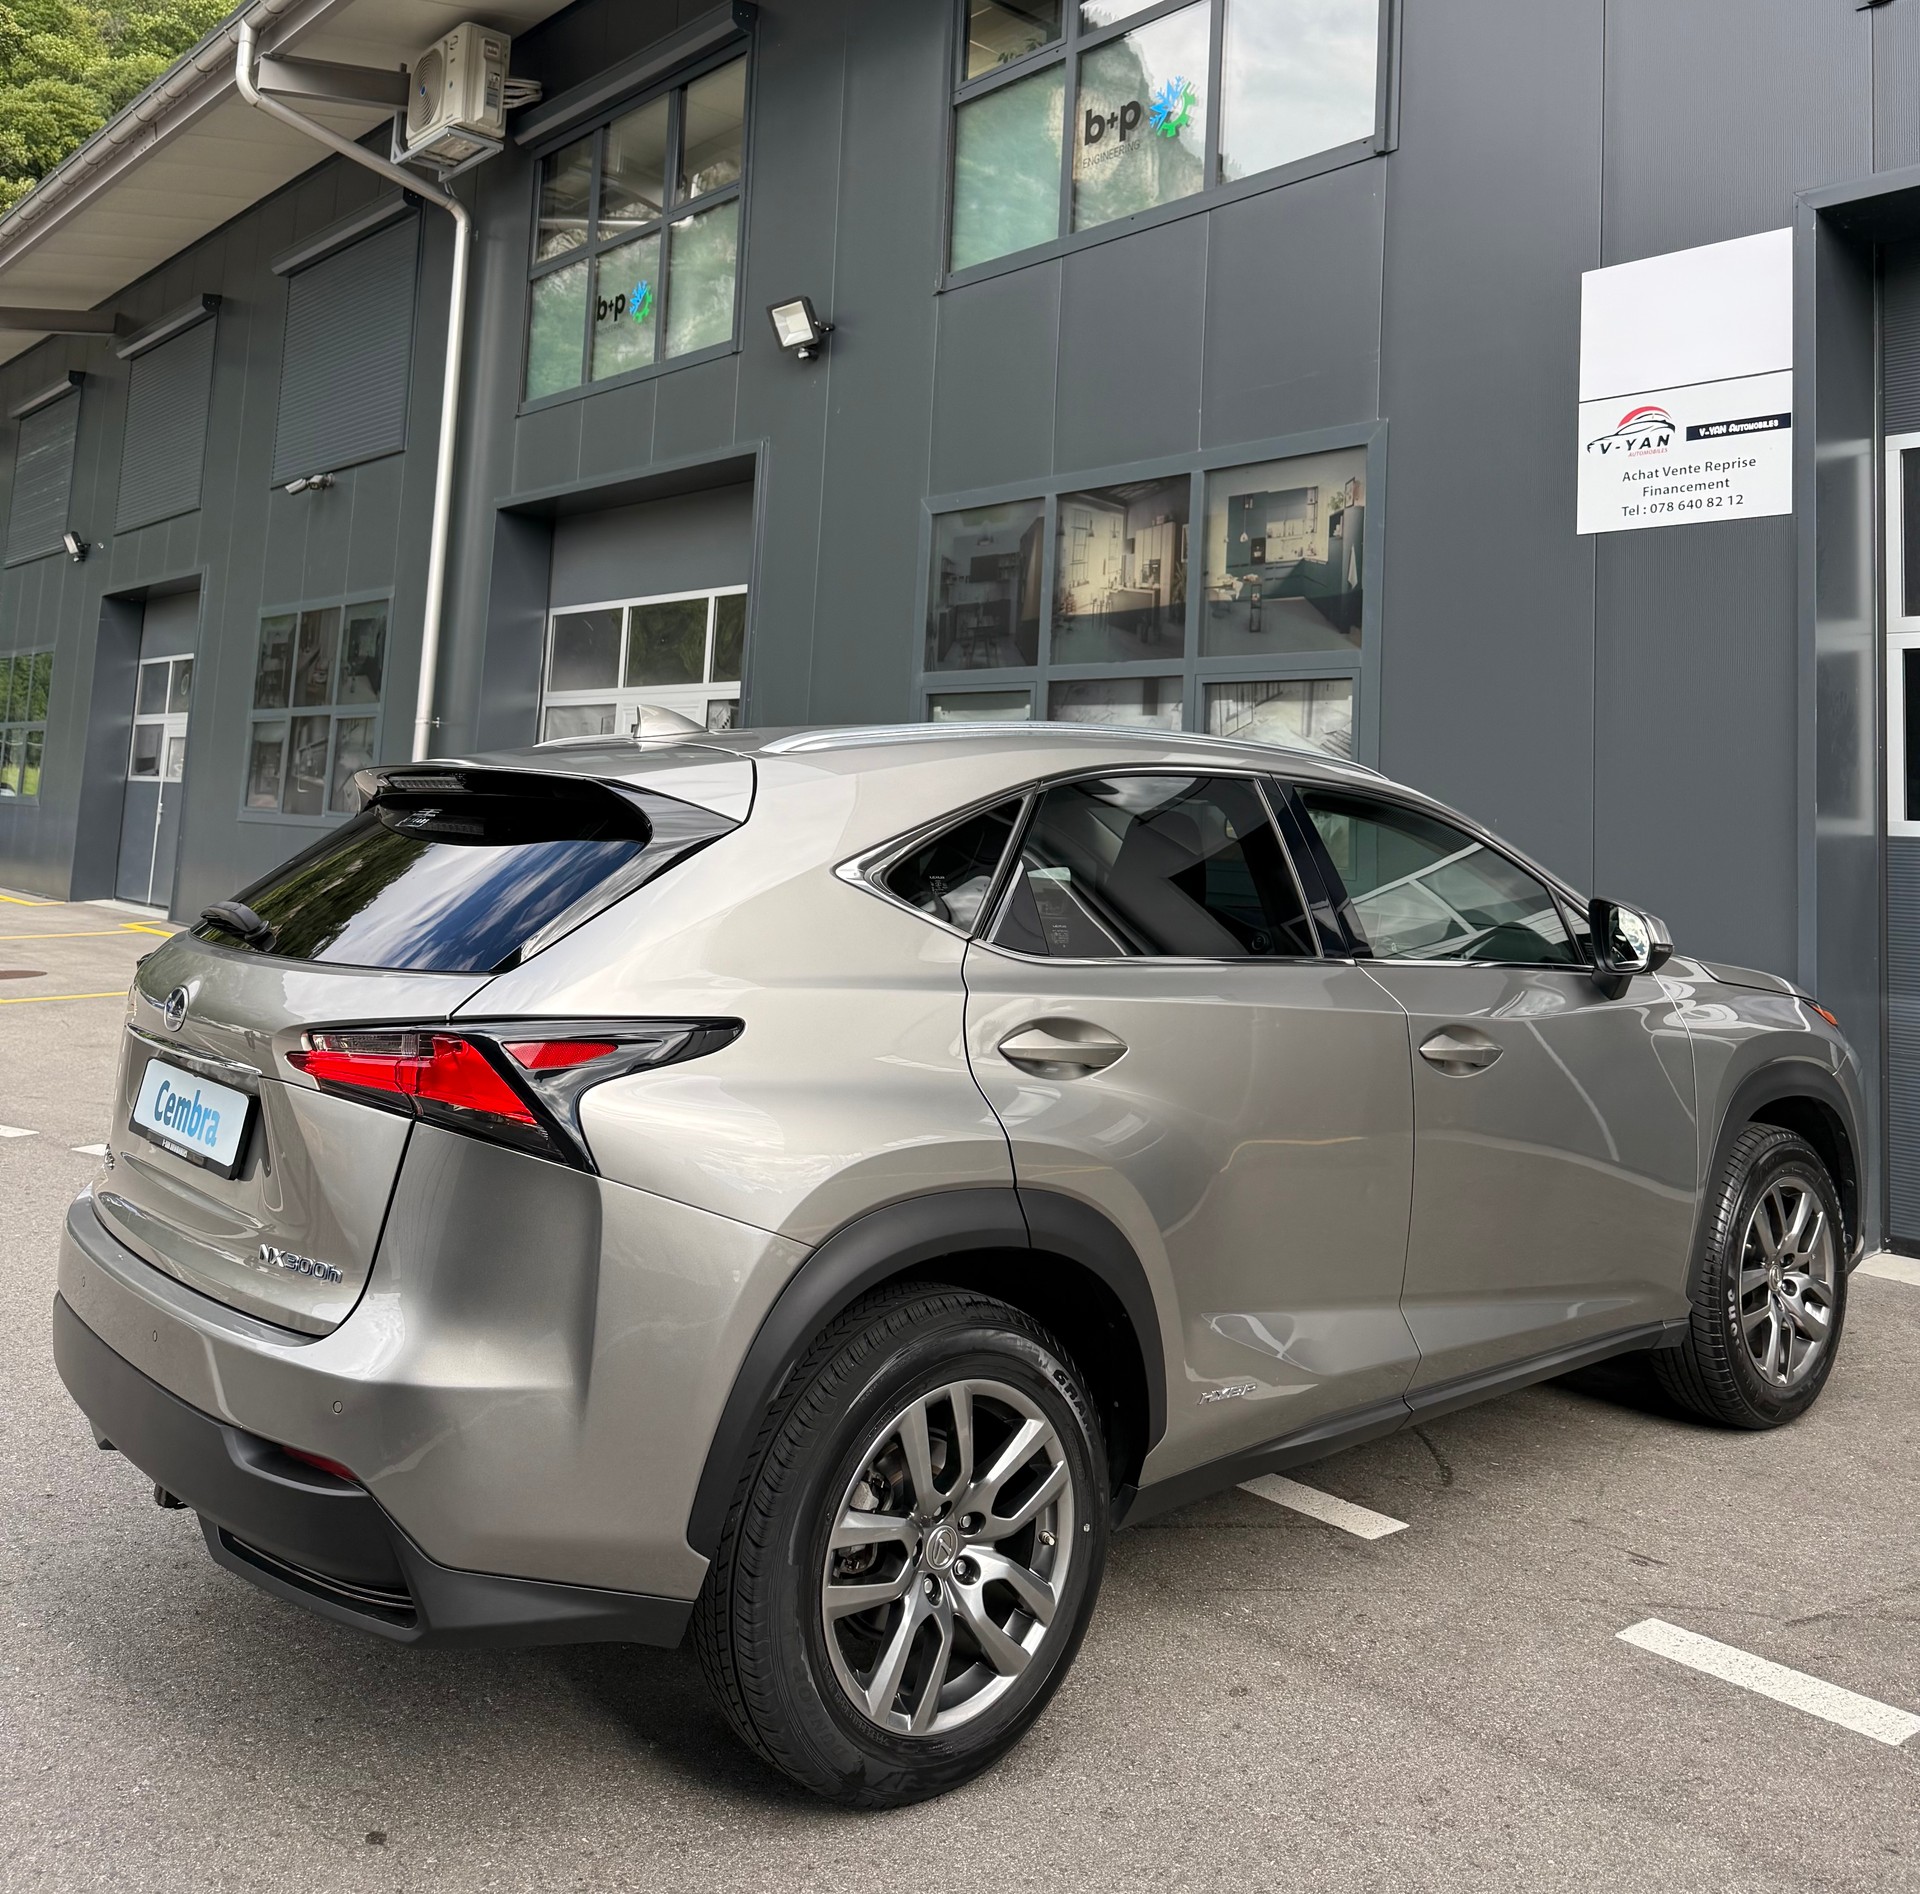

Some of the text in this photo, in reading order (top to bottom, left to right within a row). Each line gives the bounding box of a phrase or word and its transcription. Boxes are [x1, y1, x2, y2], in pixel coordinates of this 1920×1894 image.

[1085, 101, 1141, 146] b+p
[1082, 140, 1140, 168] ENGINEERING
[597, 293, 626, 322] b+p
[1699, 425, 1727, 437] V-YAN
[1600, 434, 1670, 454] V-YAN
[1628, 447, 1668, 457] AUTOMOBILES
[1622, 457, 1757, 482] Achat Vente Reprise
[1642, 478, 1730, 497] Financement
[1650, 501, 1674, 514] 078
[1678, 499, 1703, 511] 640
[1706, 496, 1723, 508] 82
[1728, 494, 1744, 505] 12
[154, 1080, 220, 1148] Cembra
[259, 1243, 343, 1284] NX300h
